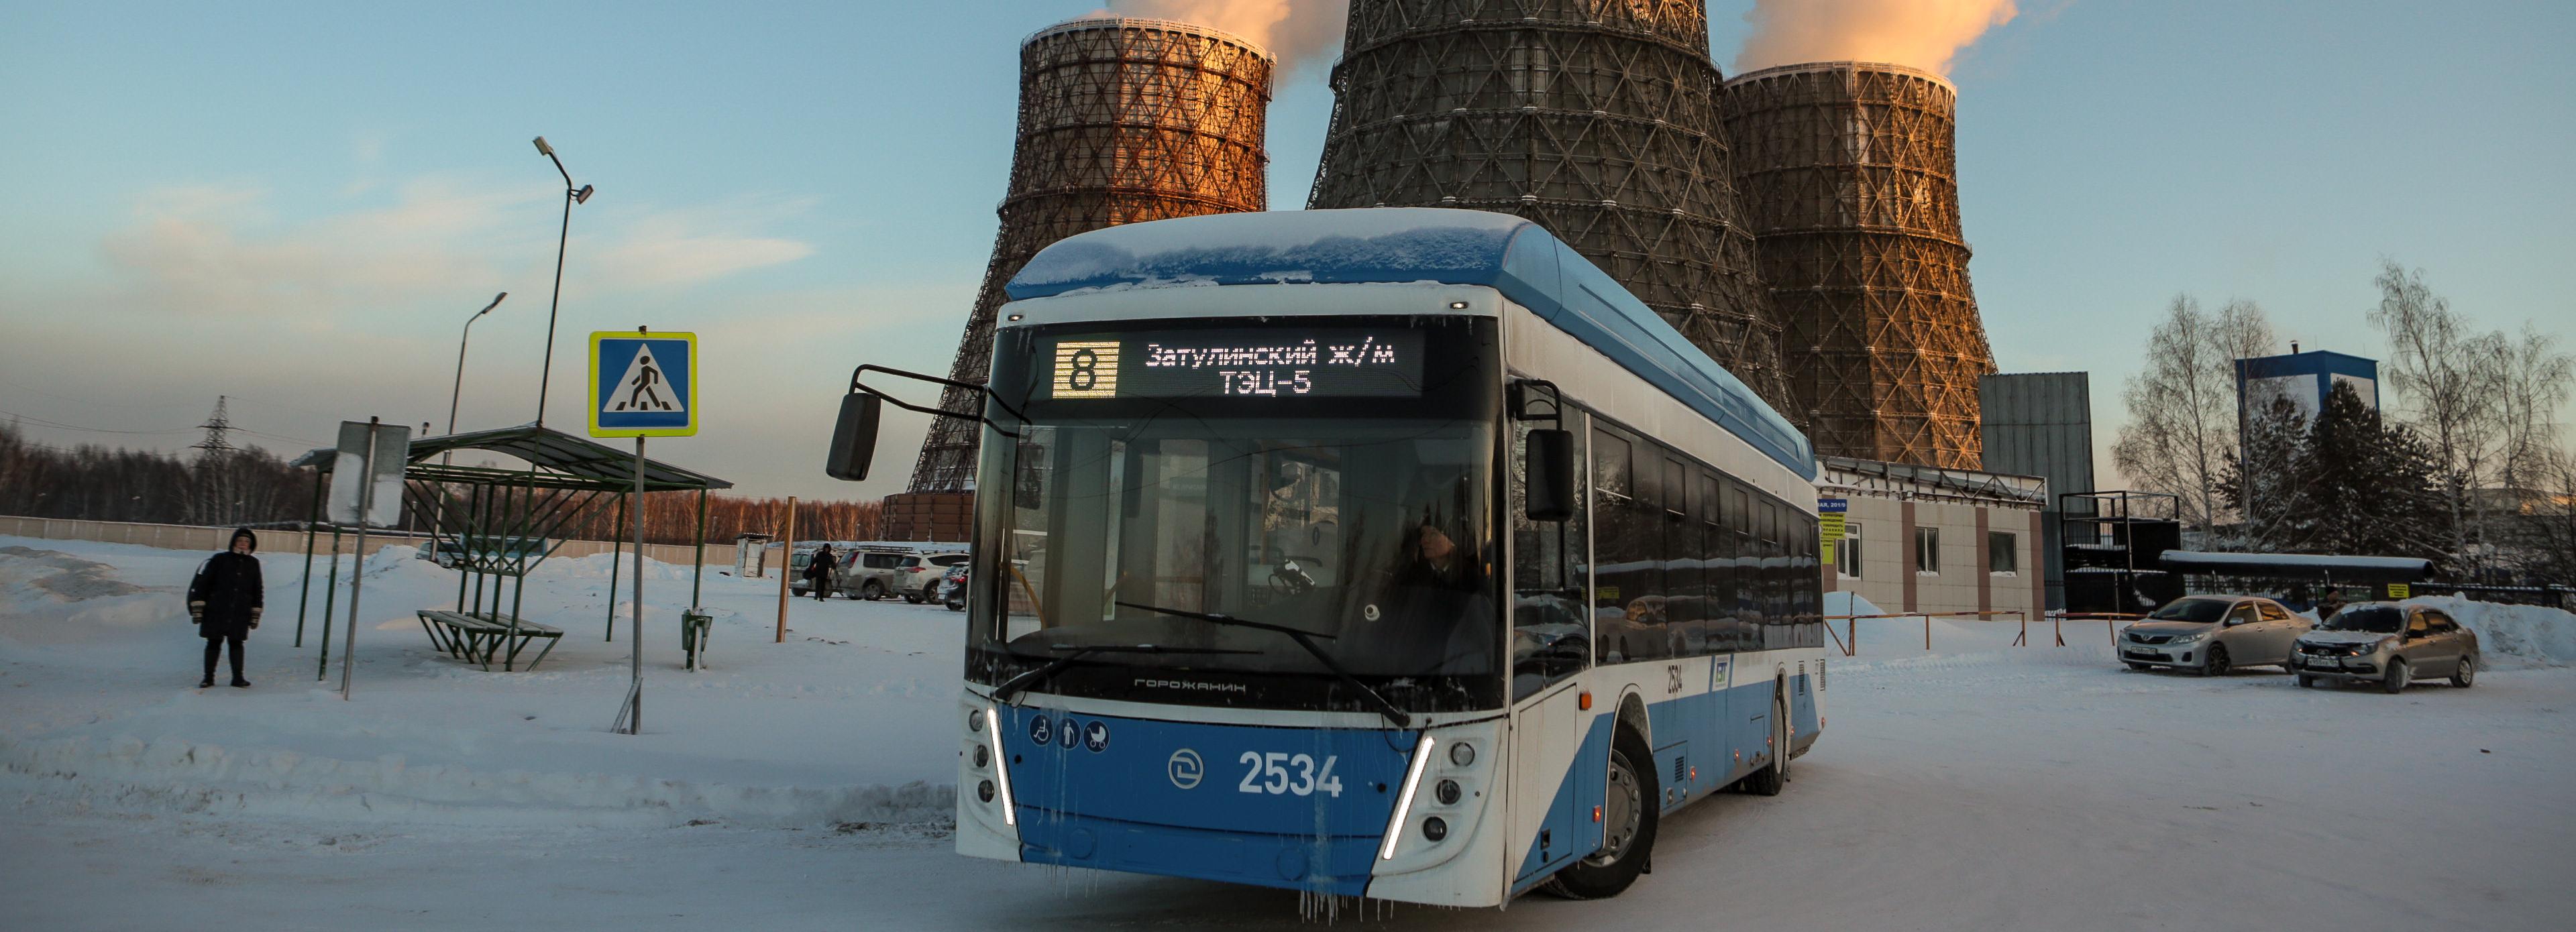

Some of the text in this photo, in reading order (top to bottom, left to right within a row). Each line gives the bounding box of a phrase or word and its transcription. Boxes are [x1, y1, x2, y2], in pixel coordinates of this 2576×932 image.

[1145, 336, 1395, 369] Затулинский ж/м
[1069, 348, 1098, 392] 8
[1219, 370, 1311, 397] ТЭЦ-5
[1134, 679, 1246, 693] ГОРОЖАНИН
[1668, 664, 1682, 694] 2534
[1239, 750, 1342, 798] 2534
